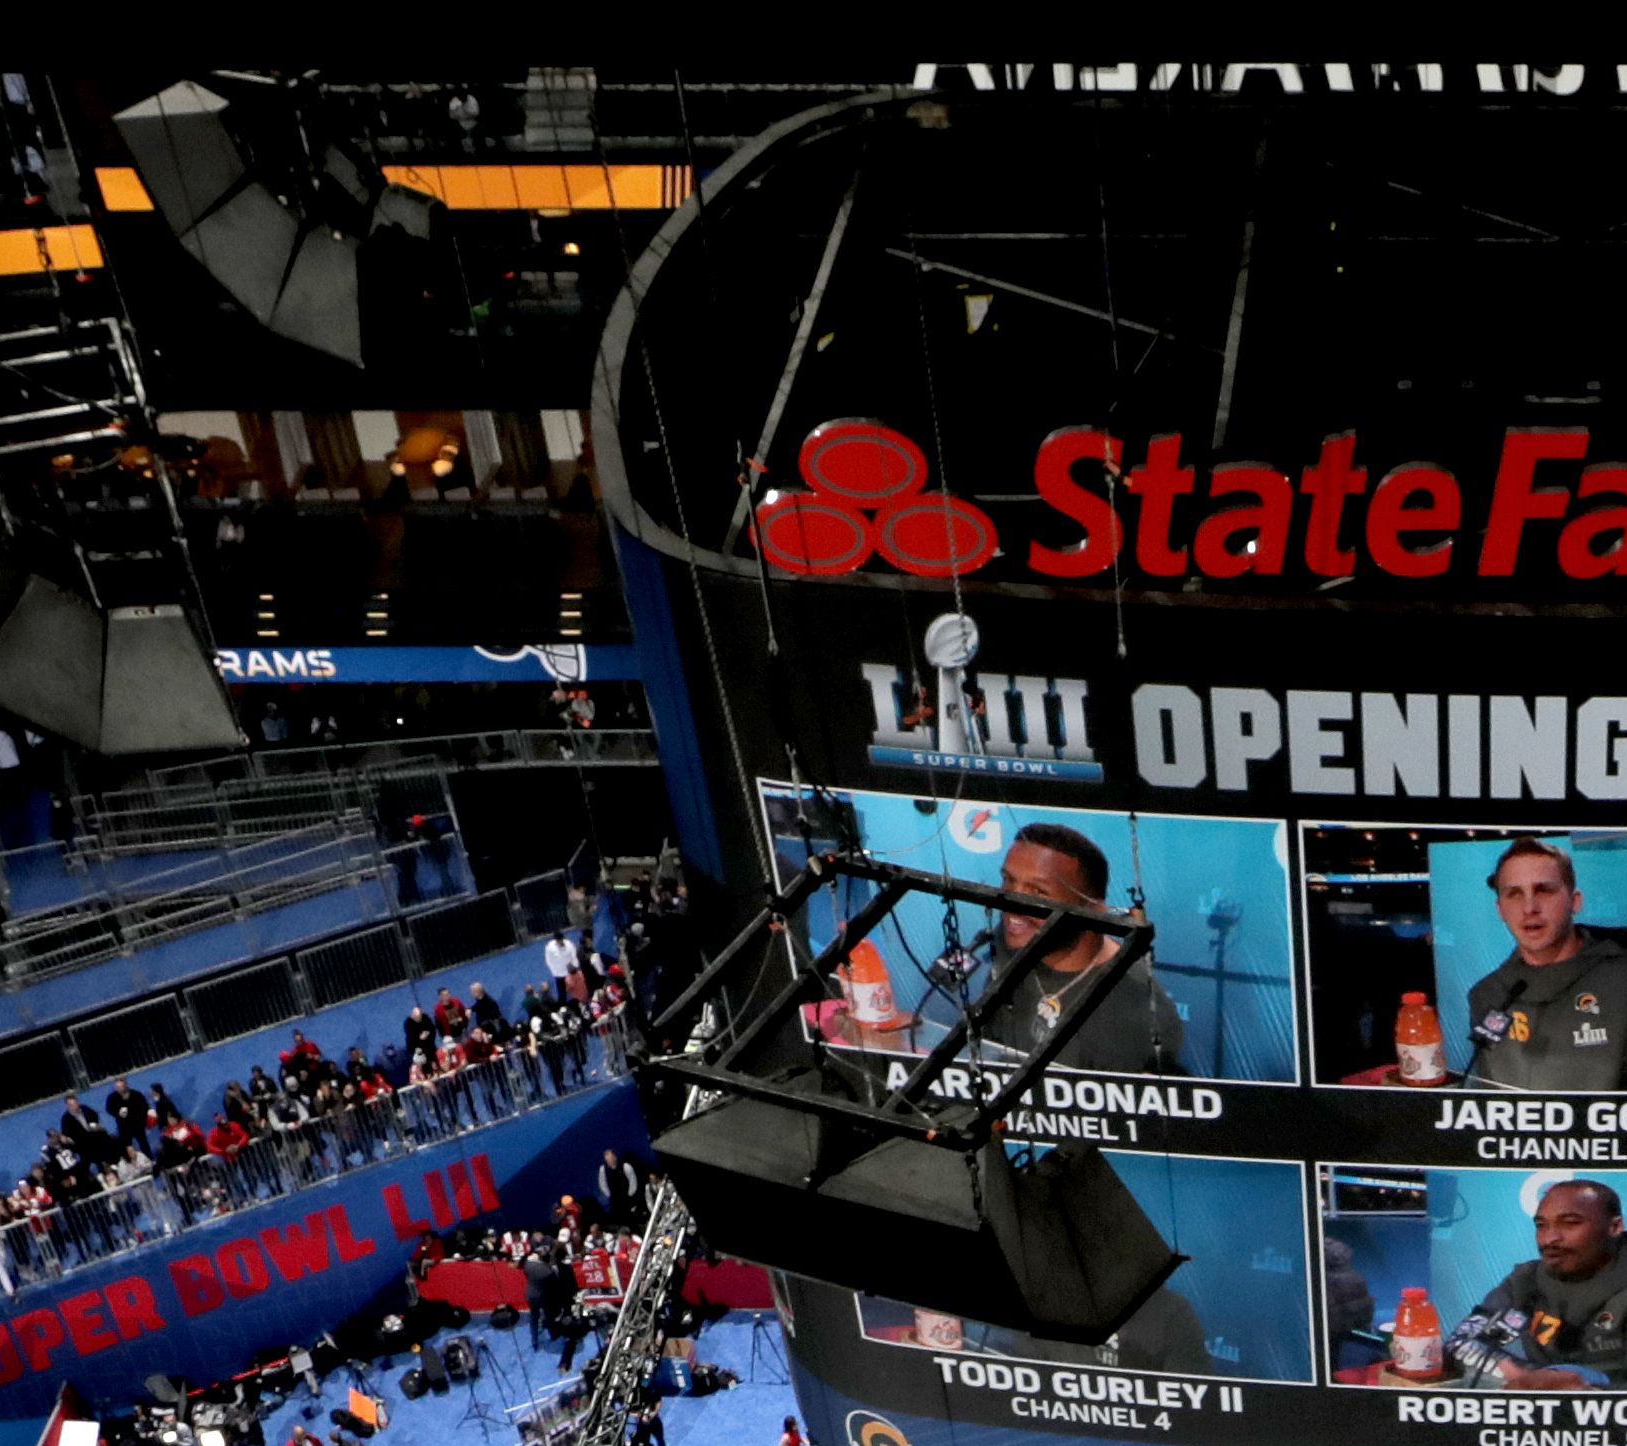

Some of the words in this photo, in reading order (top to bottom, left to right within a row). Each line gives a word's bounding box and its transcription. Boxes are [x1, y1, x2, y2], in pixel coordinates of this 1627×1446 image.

[214, 648, 337, 680] RAMS
[912, 752, 987, 772] SUPER
[997, 759, 1060, 777] BOWL
[1046, 1076, 1223, 1120] DONALD
[1000, 1113, 1117, 1141] HANNEL
[1126, 1117, 1139, 1142] 1
[1434, 1100, 1574, 1132] JARED
[1477, 1137, 1625, 1162] CHANNEL
[173, 1201, 376, 1319] BOWL
[380, 1152, 502, 1244] LIII
[933, 1356, 1041, 1395] TODD
[1052, 1372, 1209, 1411] GURLEY
[1219, 1386, 1244, 1413] II
[1011, 1396, 1146, 1430] CHANNEL
[1153, 1411, 1173, 1432] 4
[1398, 1396, 1561, 1426] ROBERT
